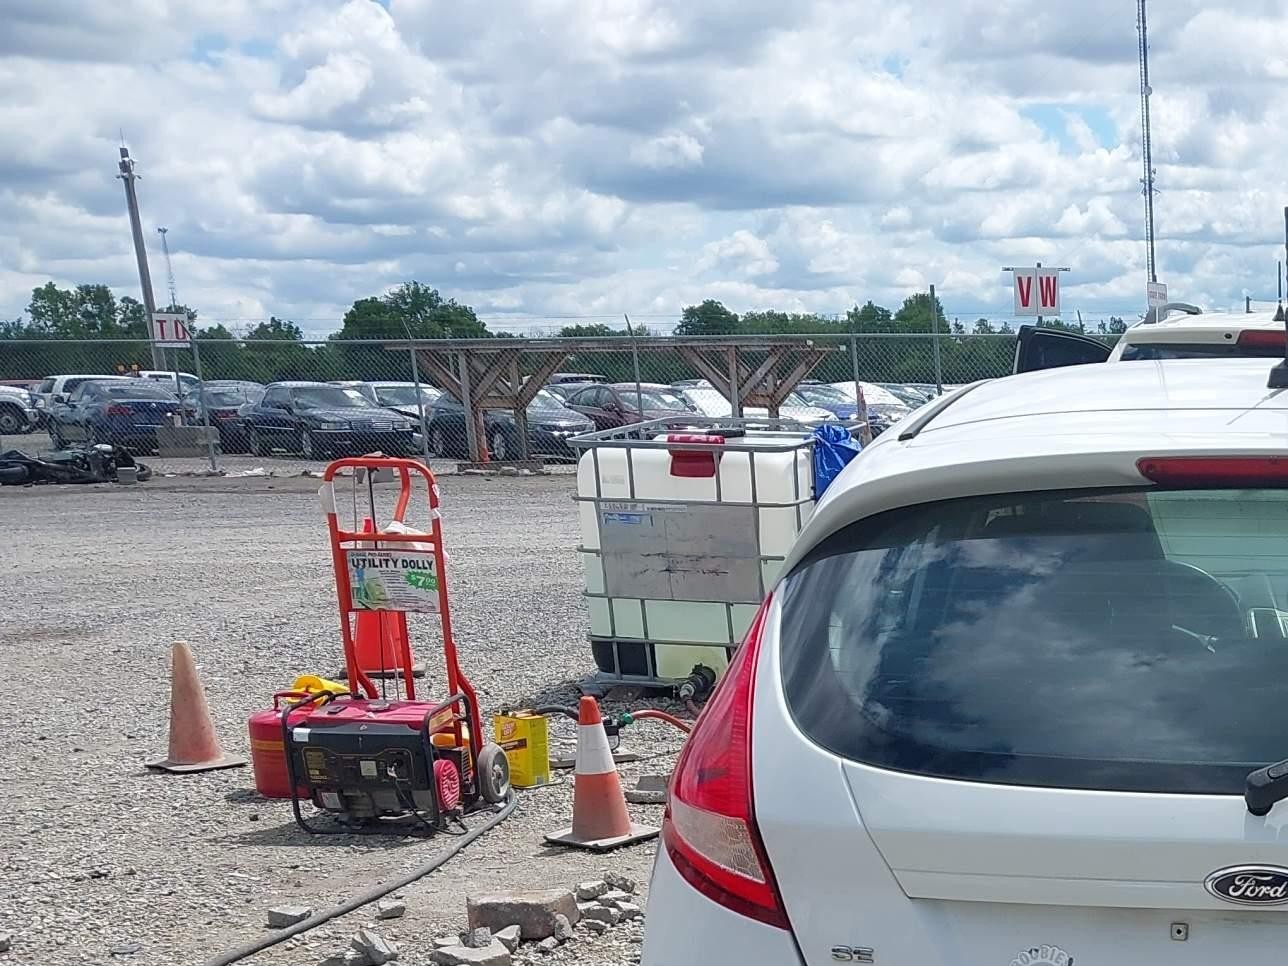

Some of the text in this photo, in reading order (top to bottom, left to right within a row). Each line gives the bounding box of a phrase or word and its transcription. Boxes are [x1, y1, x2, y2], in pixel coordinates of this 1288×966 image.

[1017, 276, 1057, 307] V W
[155, 319, 167, 339] T
[352, 559, 434, 570] UTILITY DOLLY
[1228, 874, 1288, 897] Ford
[831, 944, 874, 963] SE
